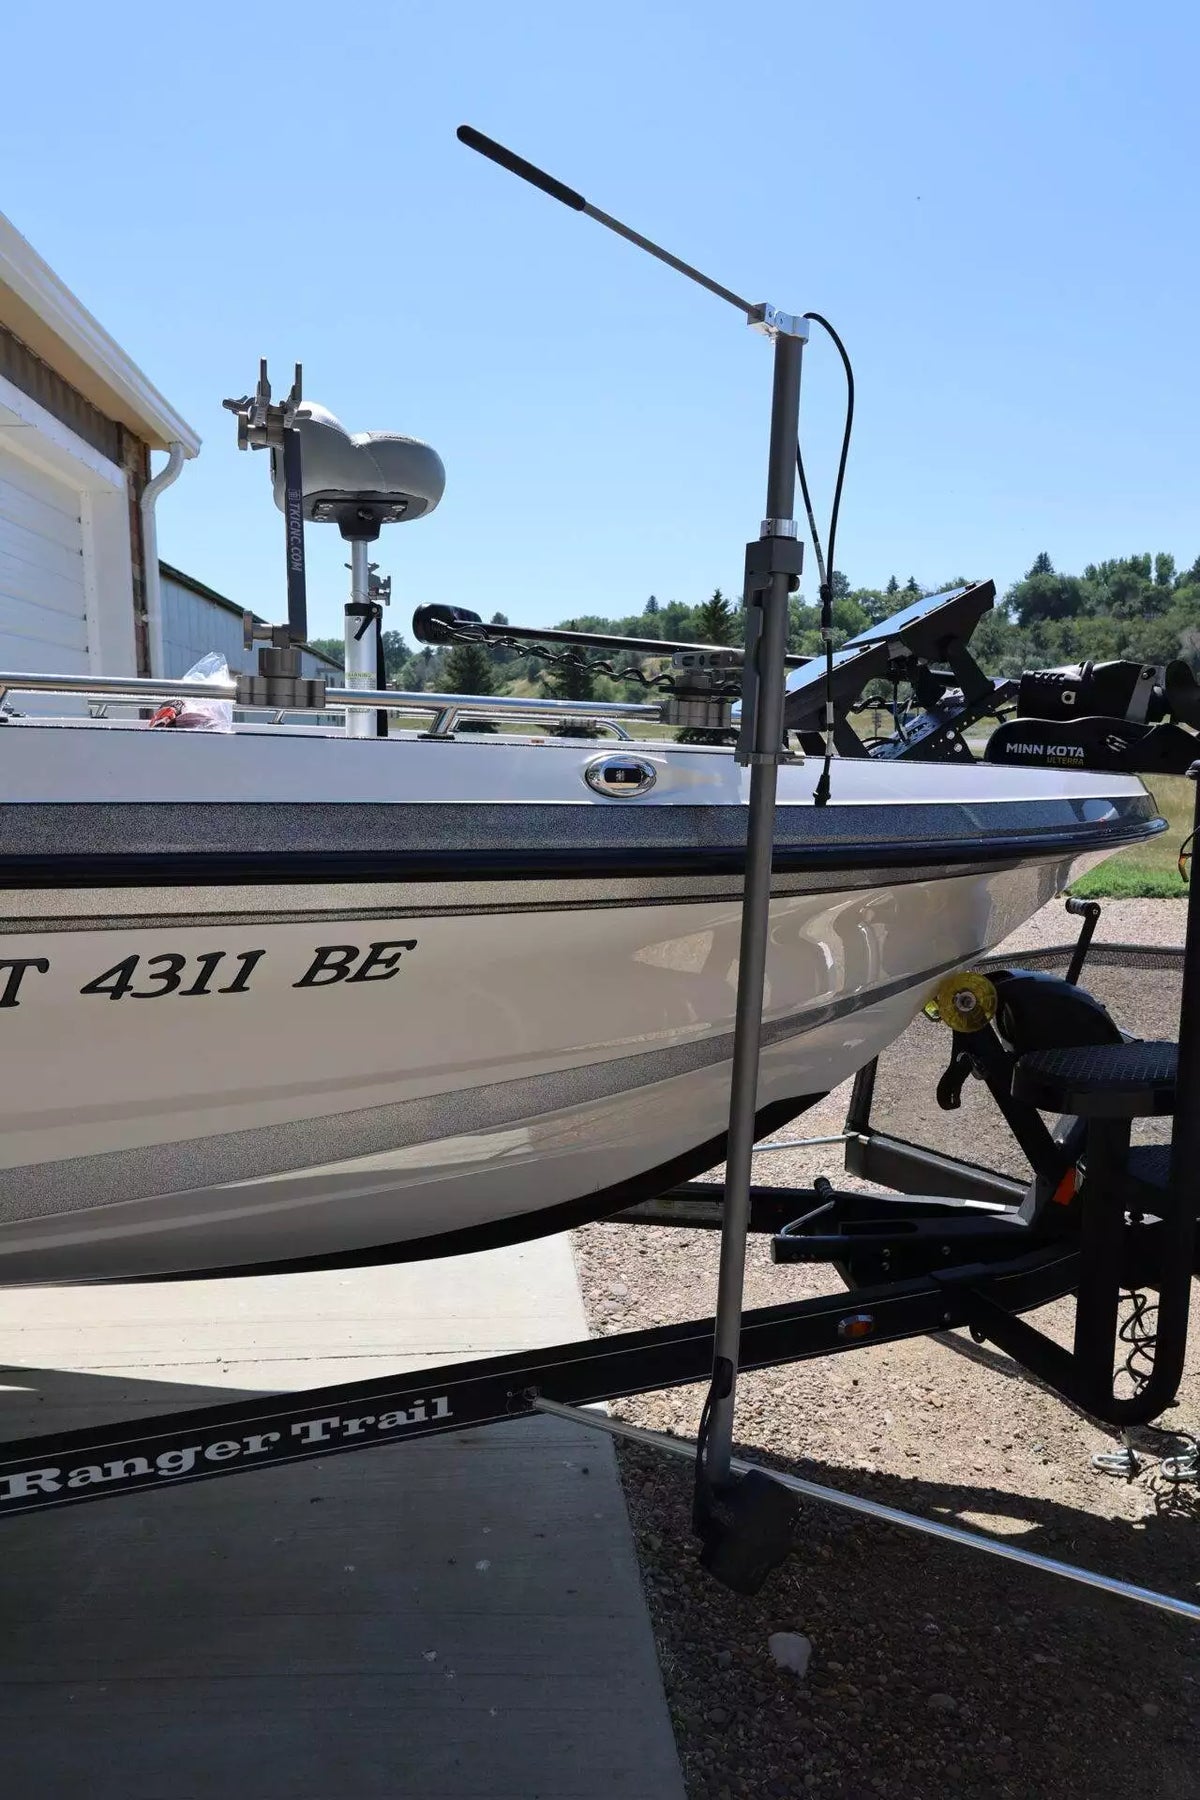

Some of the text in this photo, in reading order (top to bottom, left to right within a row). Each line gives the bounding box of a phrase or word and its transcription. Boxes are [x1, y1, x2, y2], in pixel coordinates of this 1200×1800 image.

[1005, 742, 1085, 758] MINN KOTA
[1046, 756, 1084, 767] ULTERRA
[79, 949, 267, 1000] 4311
[291, 939, 418, 988] BE
[0, 1395, 454, 1501] Ranger Trail
